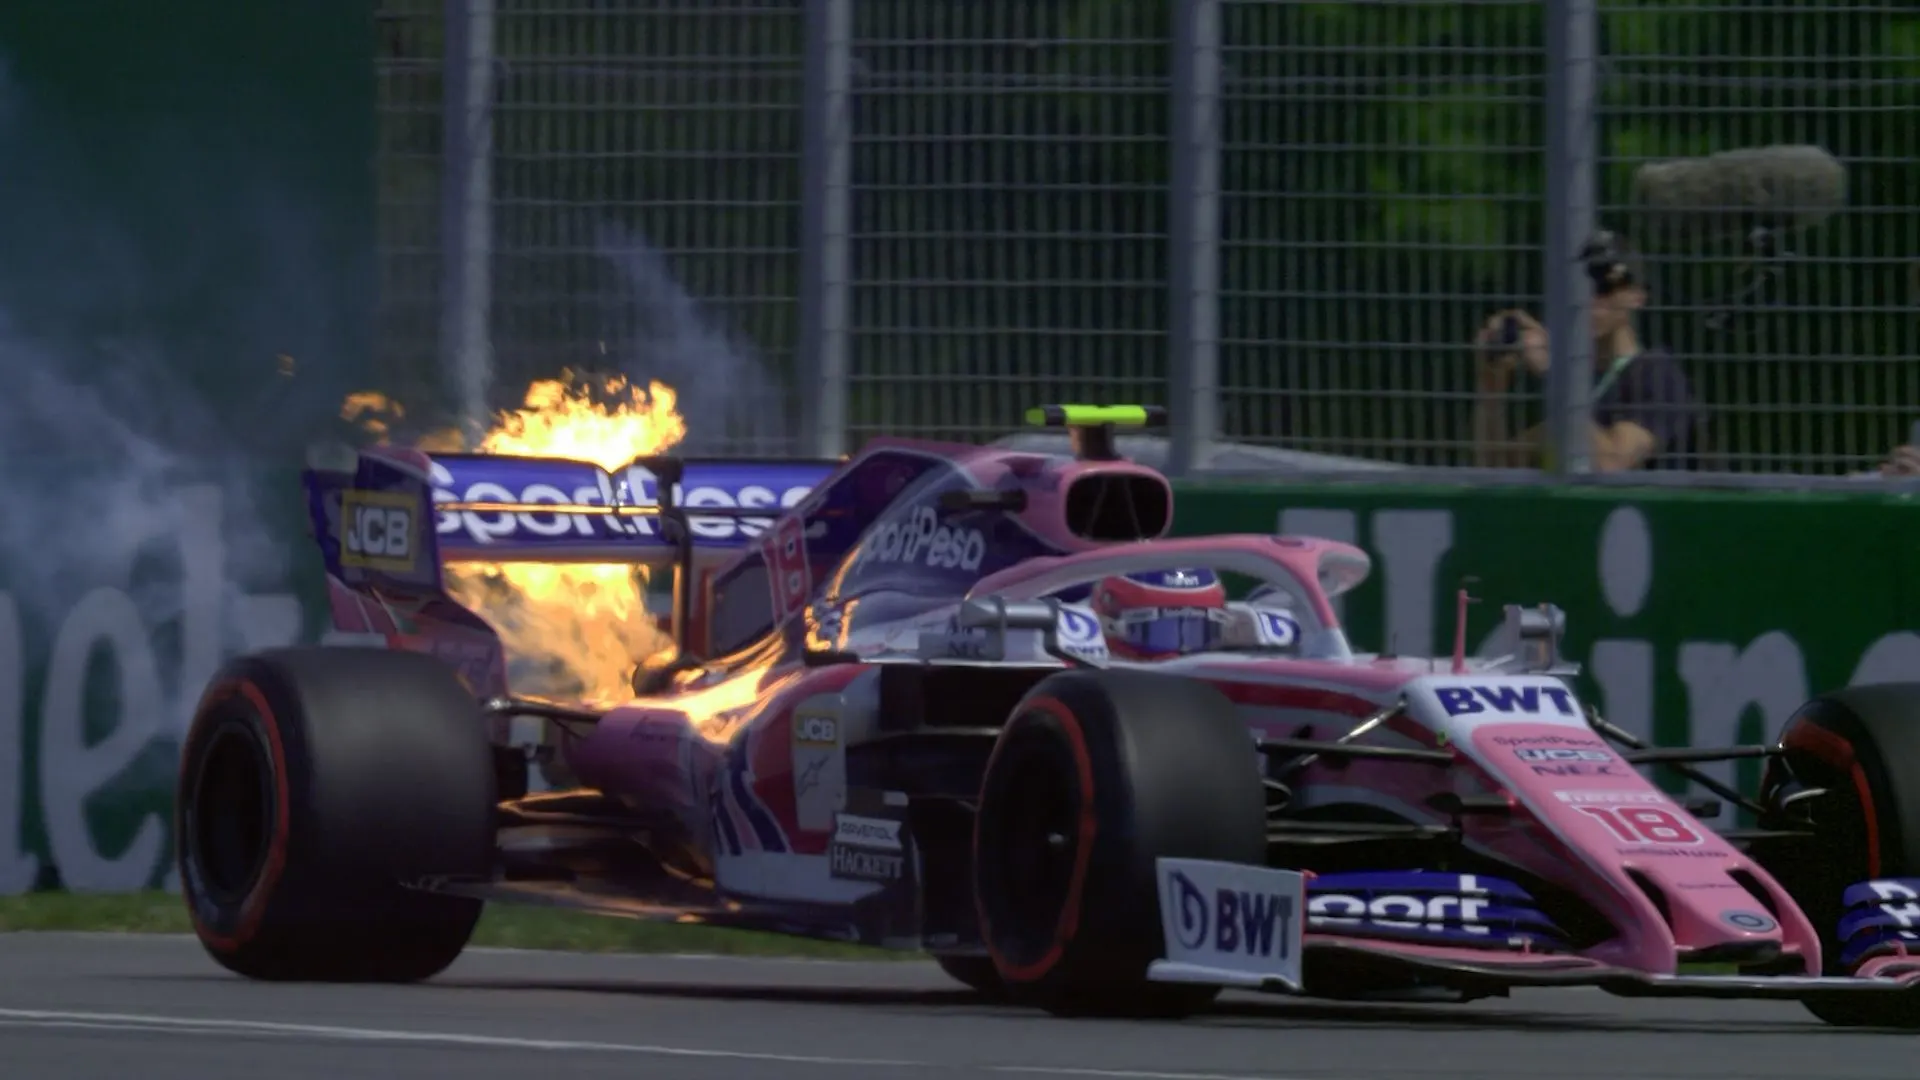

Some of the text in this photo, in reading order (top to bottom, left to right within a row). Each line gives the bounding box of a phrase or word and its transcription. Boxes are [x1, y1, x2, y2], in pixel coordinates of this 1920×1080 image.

[346, 507, 411, 556] JCB
[1435, 686, 1578, 717] BWT
[1520, 749, 1612, 761] JCB
[1571, 805, 1705, 846] 18
[1214, 887, 1293, 958] BWT
